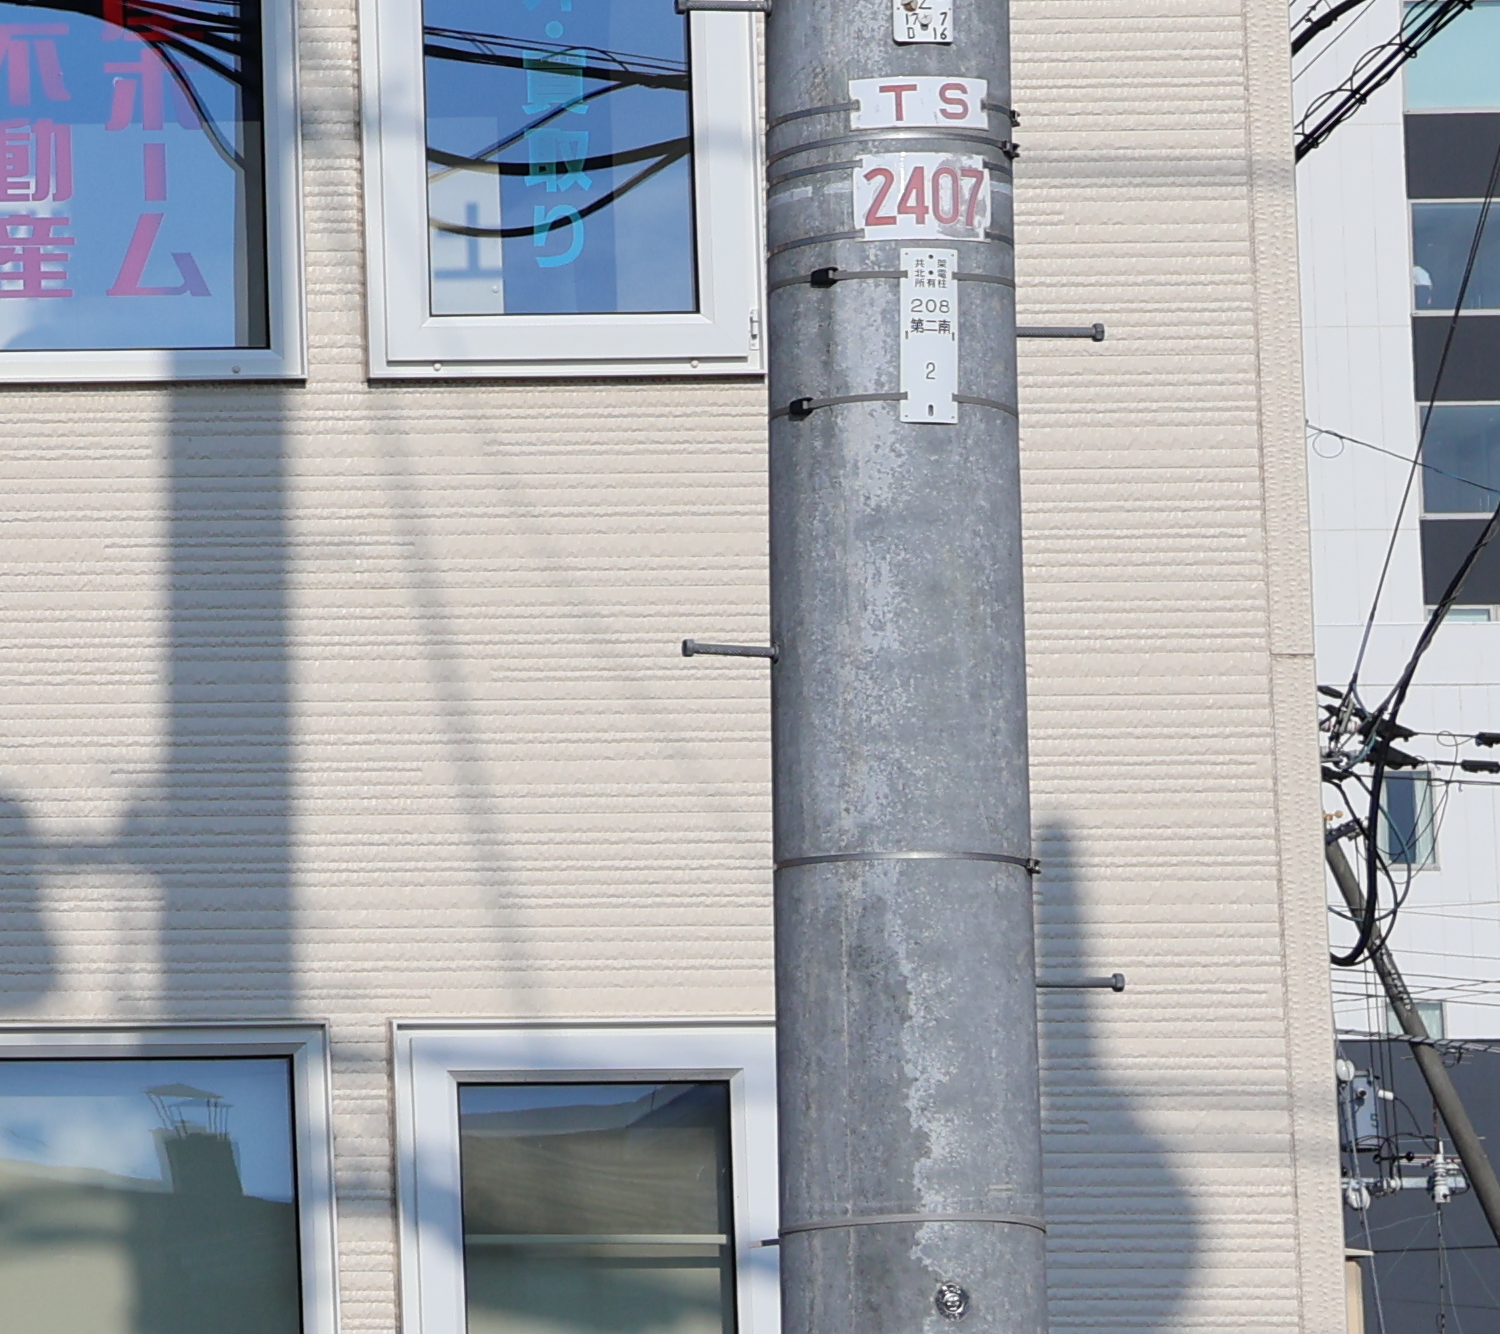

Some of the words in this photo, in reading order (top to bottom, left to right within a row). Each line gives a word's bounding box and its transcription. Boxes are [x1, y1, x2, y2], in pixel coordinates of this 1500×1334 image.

[863, 166, 985, 227] 2407
[910, 298, 950, 313] 208
[910, 318, 951, 334] 第二南
[925, 362, 936, 380] 2
